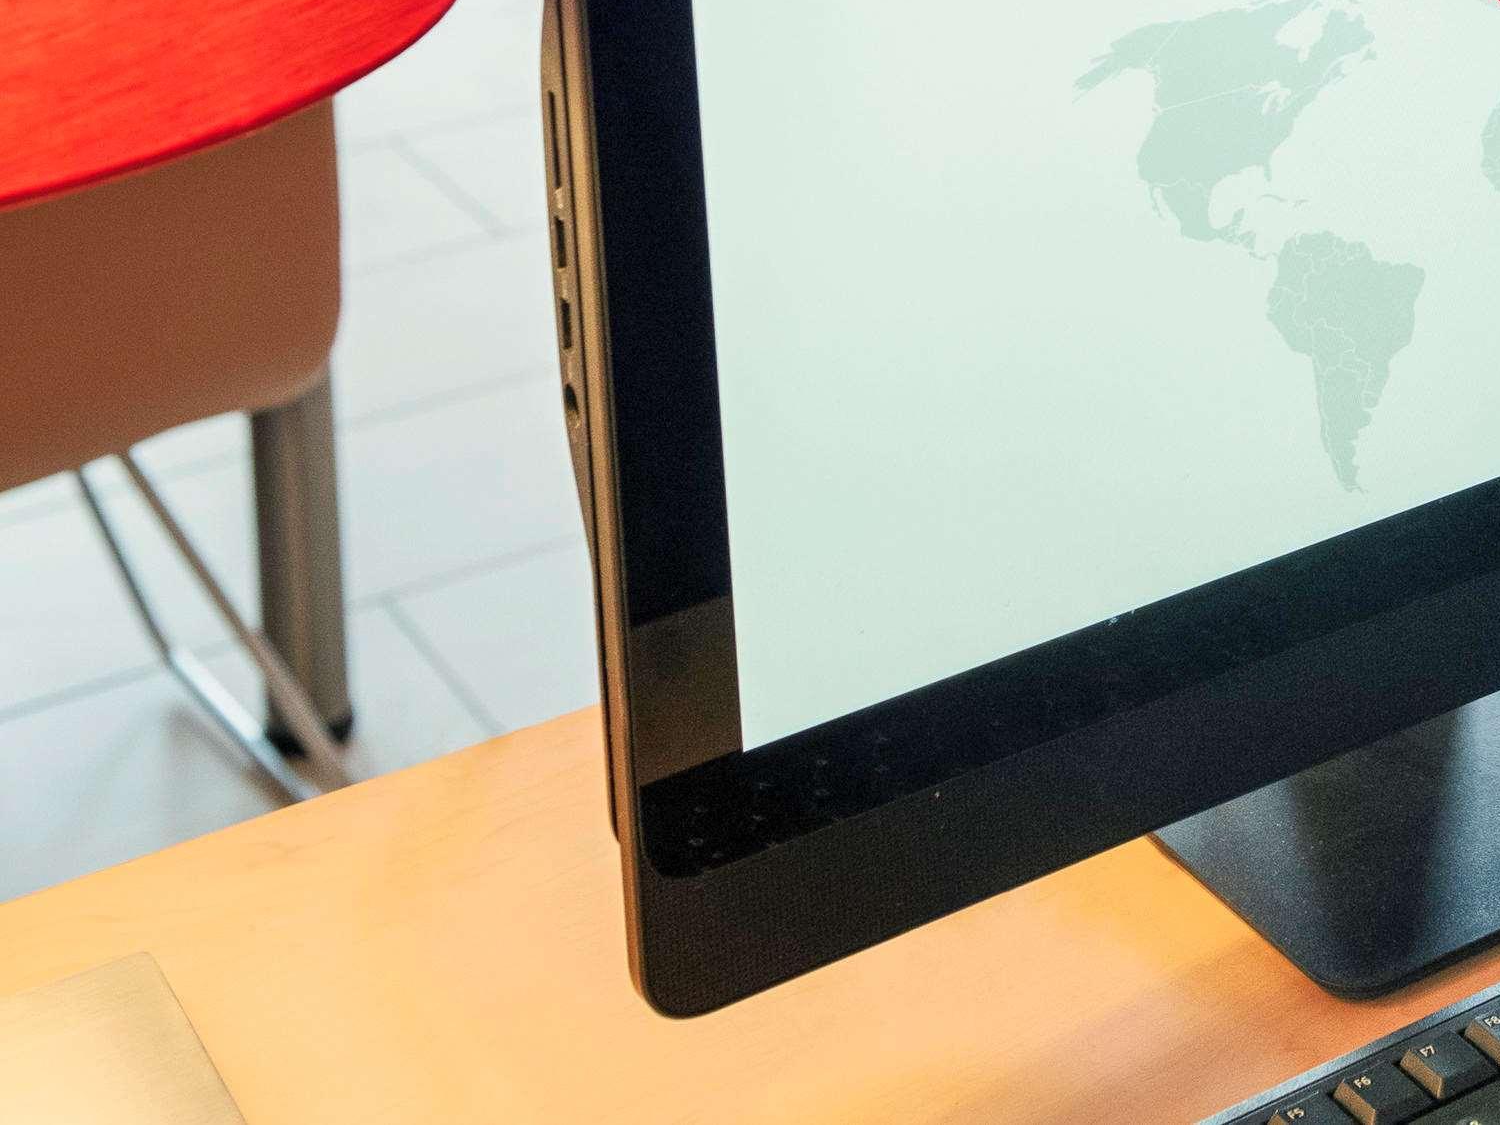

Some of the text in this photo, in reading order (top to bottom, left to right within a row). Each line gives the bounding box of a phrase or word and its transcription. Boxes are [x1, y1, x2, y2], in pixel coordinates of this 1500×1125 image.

[1419, 1045, 1436, 1058] F7
[1354, 1076, 1371, 1089] F6
[1286, 1107, 1305, 1120] F5
